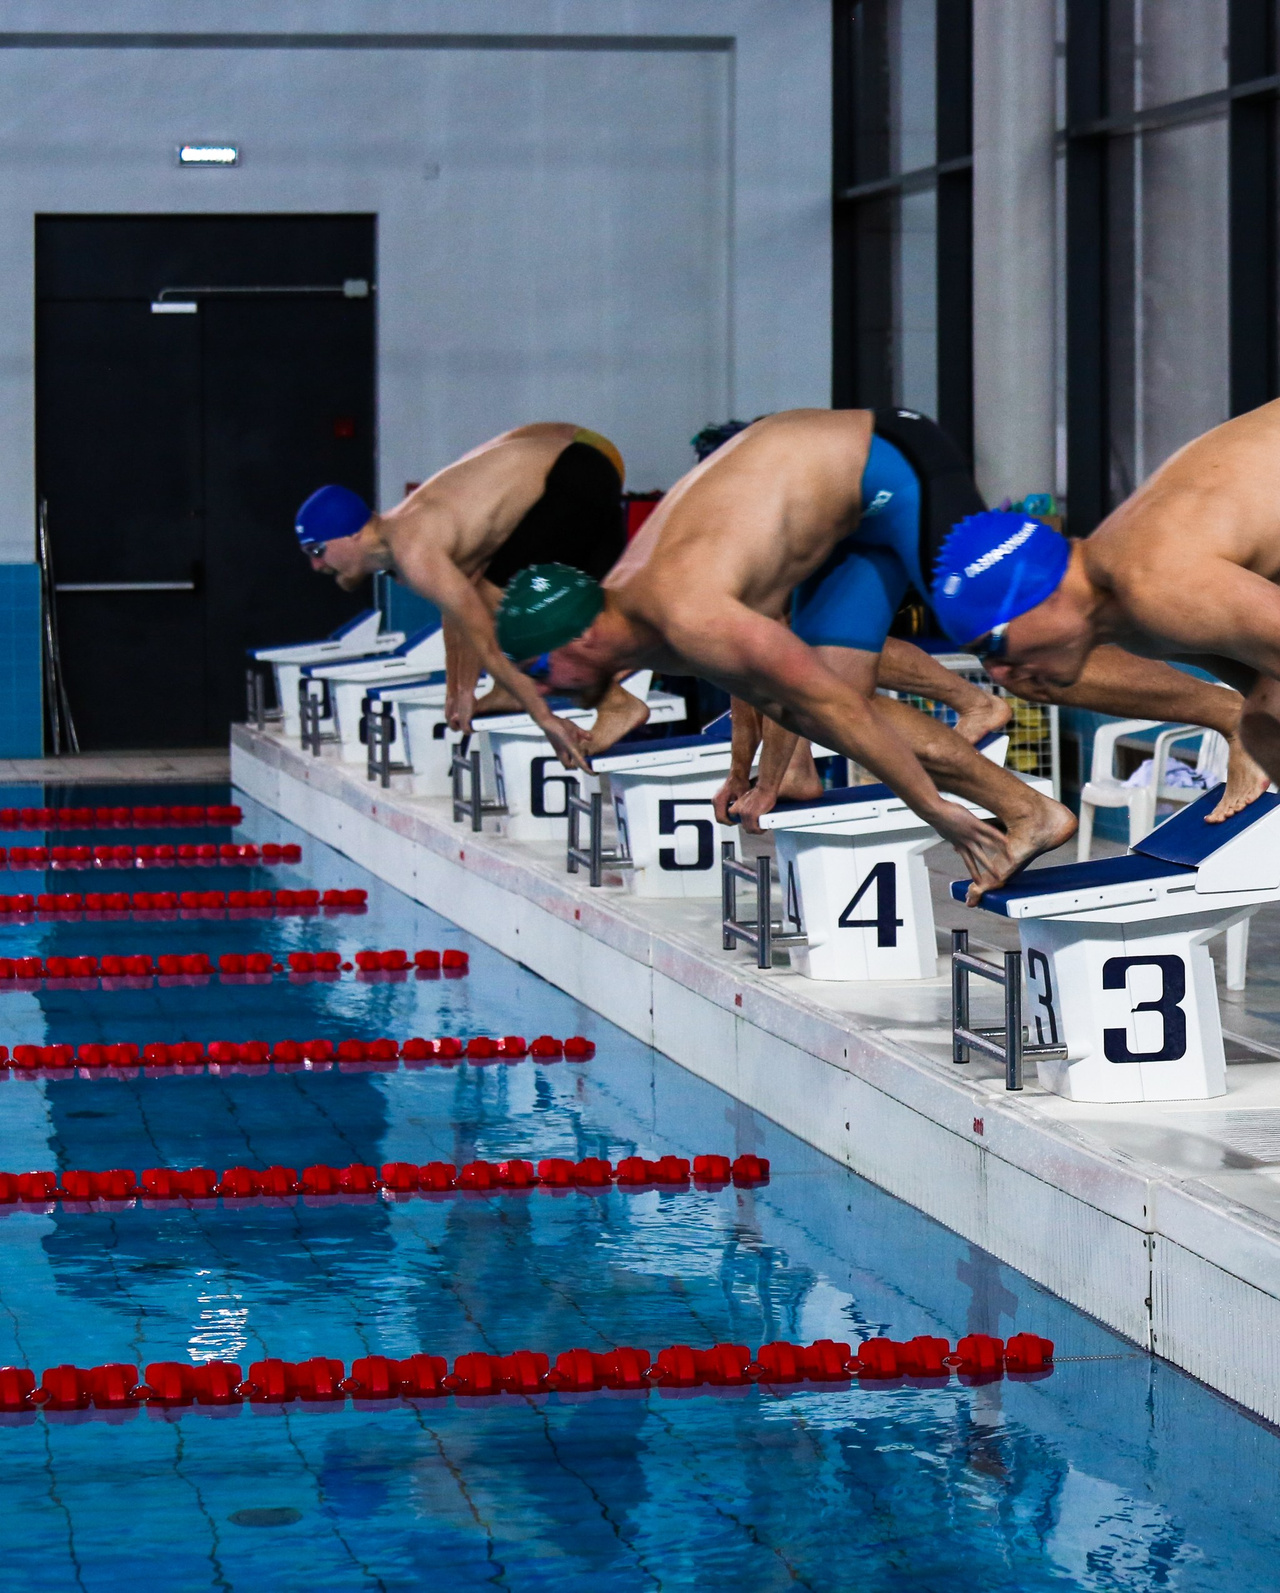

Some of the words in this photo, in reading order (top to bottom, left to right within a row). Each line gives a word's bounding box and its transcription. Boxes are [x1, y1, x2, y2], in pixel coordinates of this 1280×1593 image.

[359, 697, 396, 744] 8
[531, 757, 582, 817] 6
[659, 799, 714, 870] 5
[838, 861, 904, 947] 4
[1028, 947, 1058, 1044] 3
[1102, 954, 1187, 1063] 3
